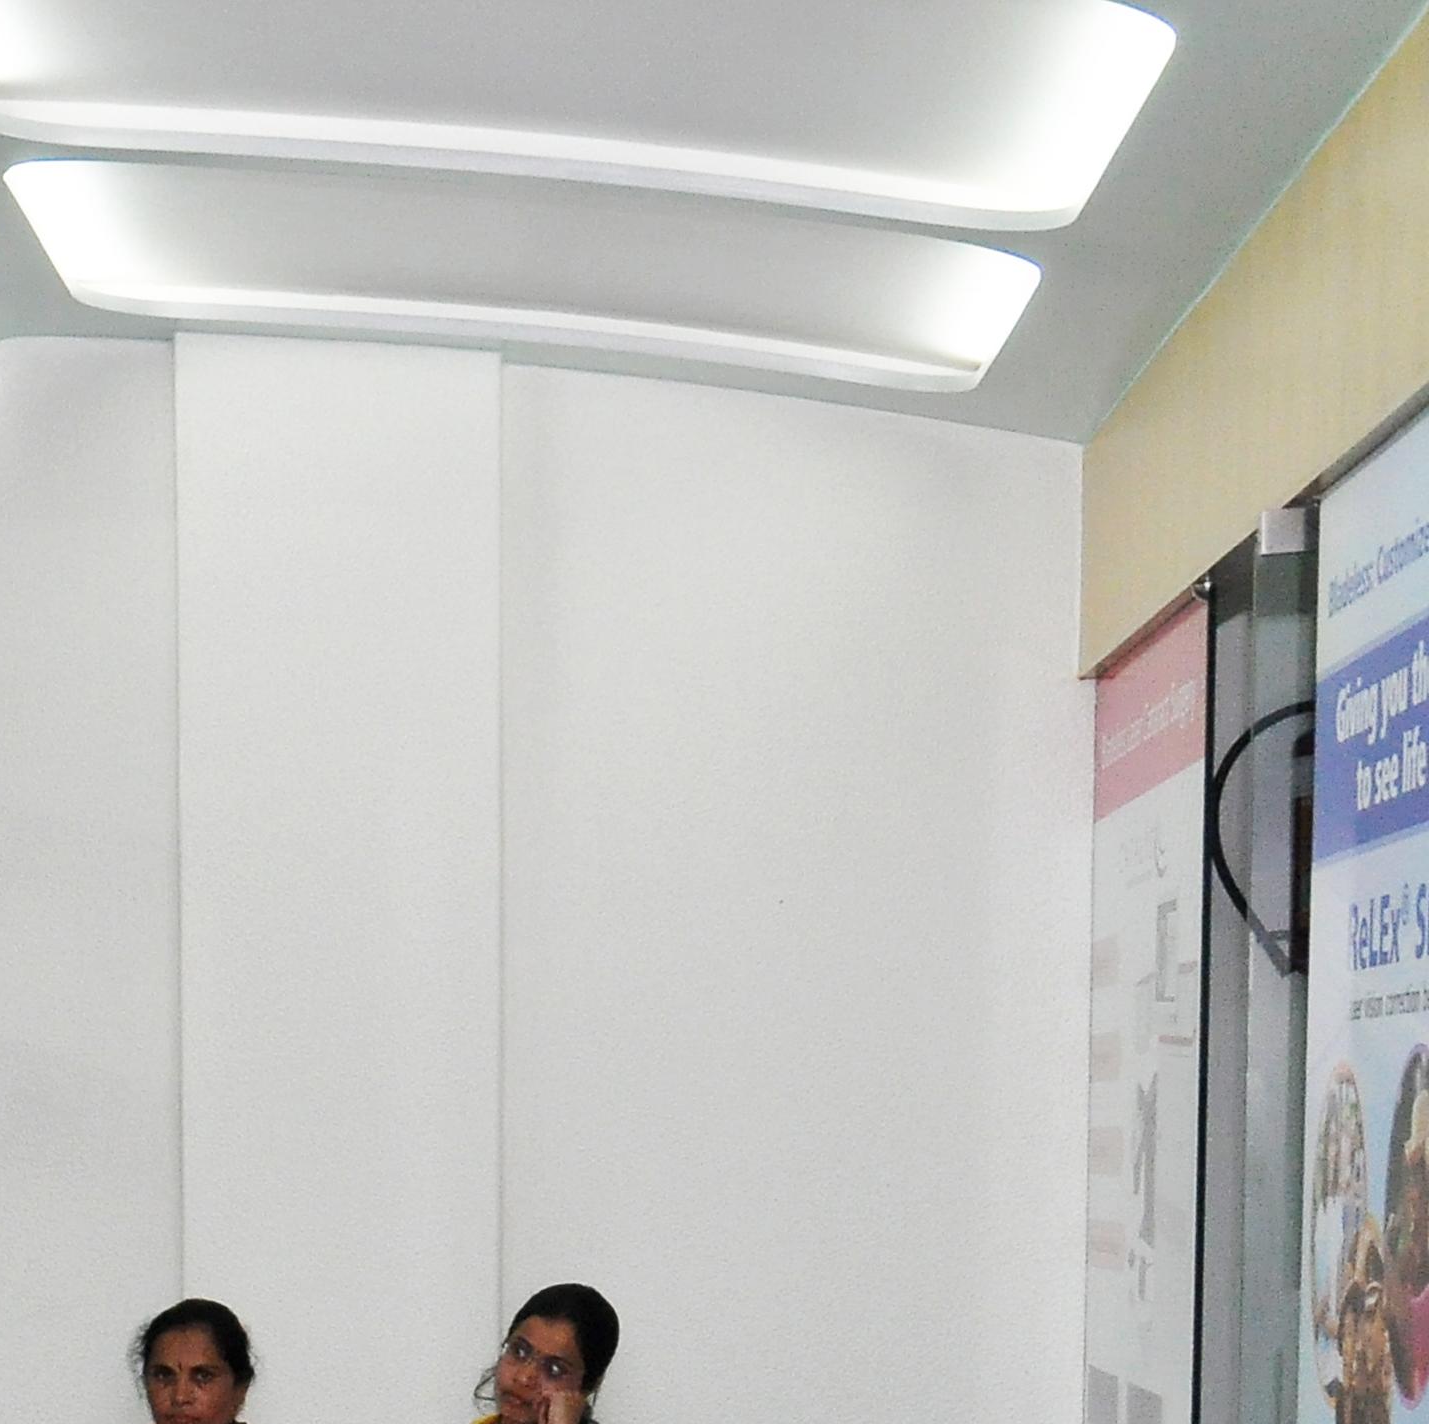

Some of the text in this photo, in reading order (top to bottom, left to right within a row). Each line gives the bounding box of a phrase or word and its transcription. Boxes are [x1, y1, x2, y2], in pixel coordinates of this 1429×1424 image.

[1335, 676, 1379, 746] Giving
[1379, 666, 1409, 740] you
[1356, 724, 1429, 812] to see life
